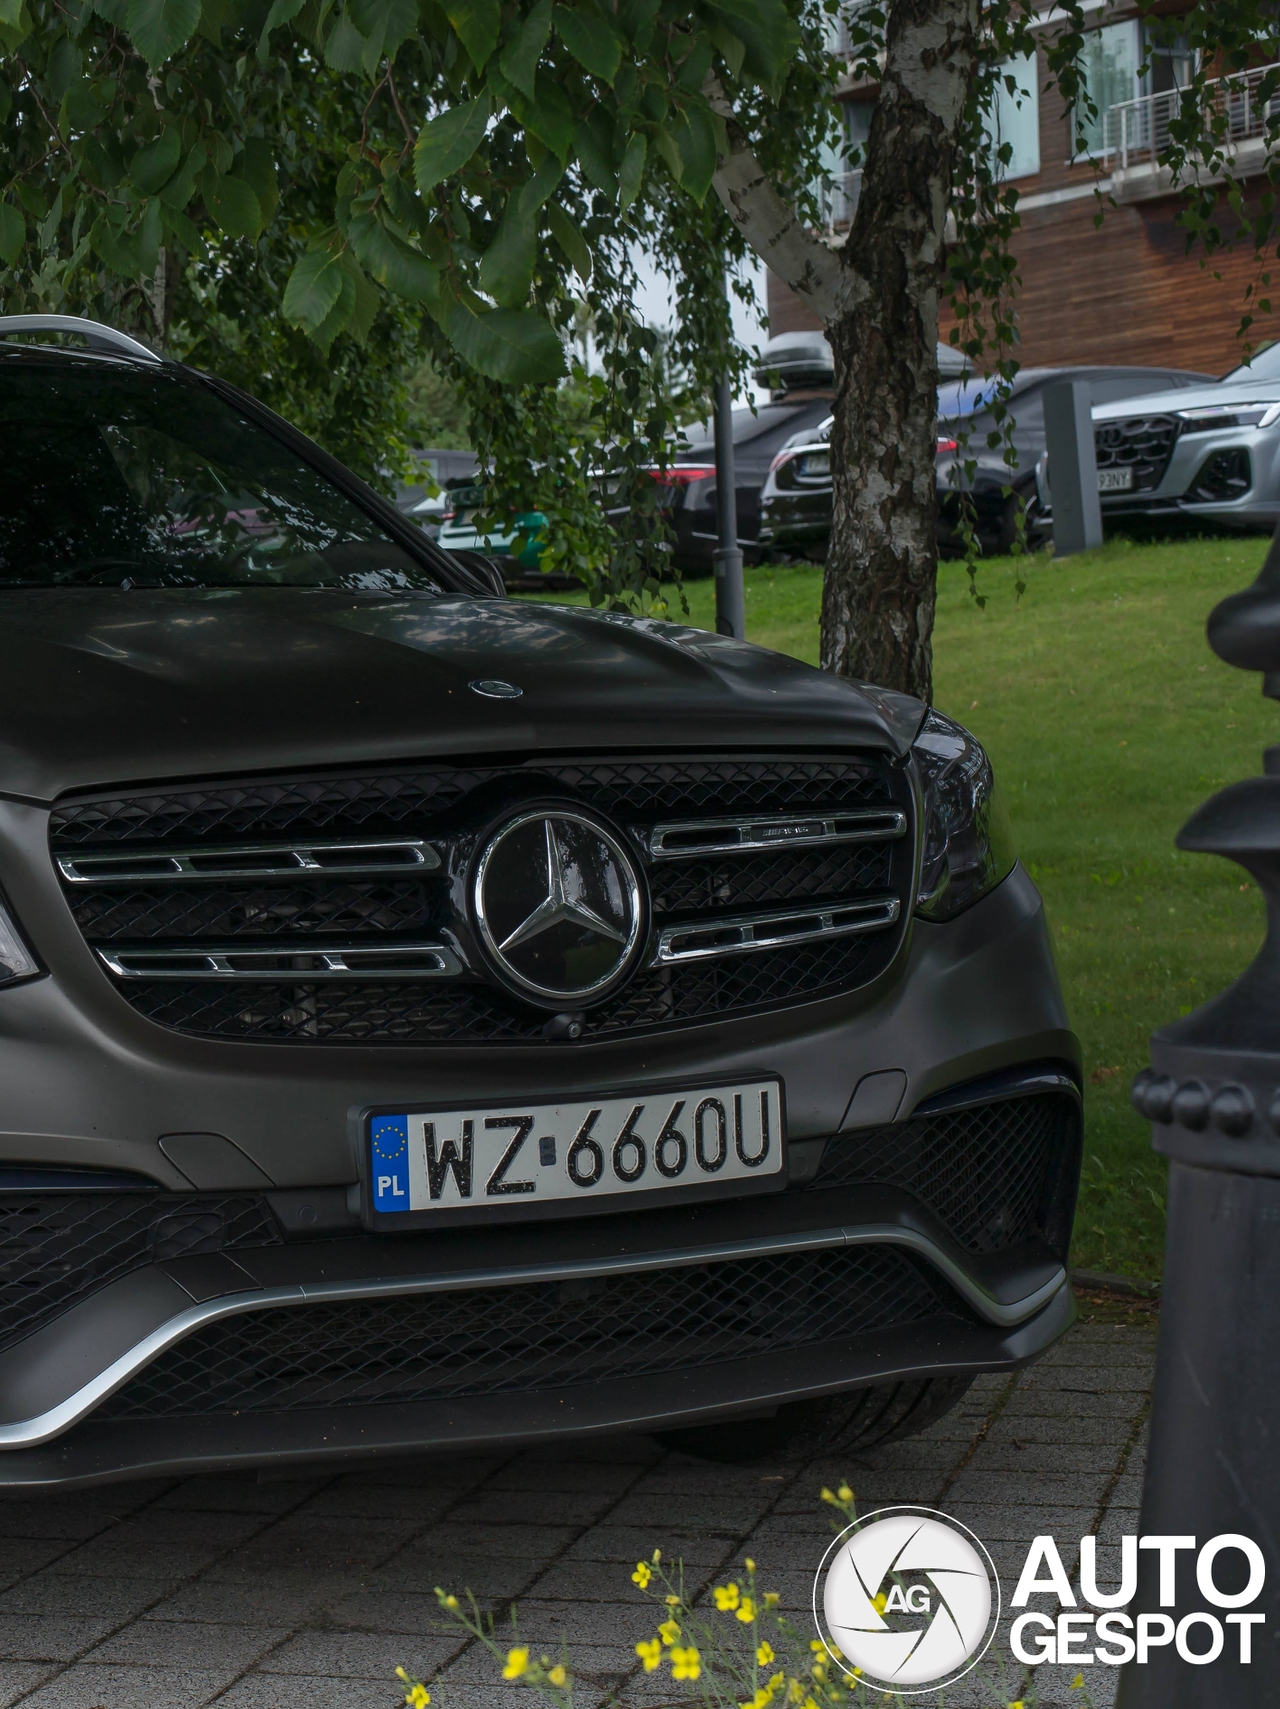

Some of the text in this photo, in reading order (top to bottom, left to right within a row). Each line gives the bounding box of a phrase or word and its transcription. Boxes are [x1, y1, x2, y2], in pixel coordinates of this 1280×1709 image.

[422, 1089, 770, 1201] WZ 6660U
[378, 1175, 405, 1197] PL
